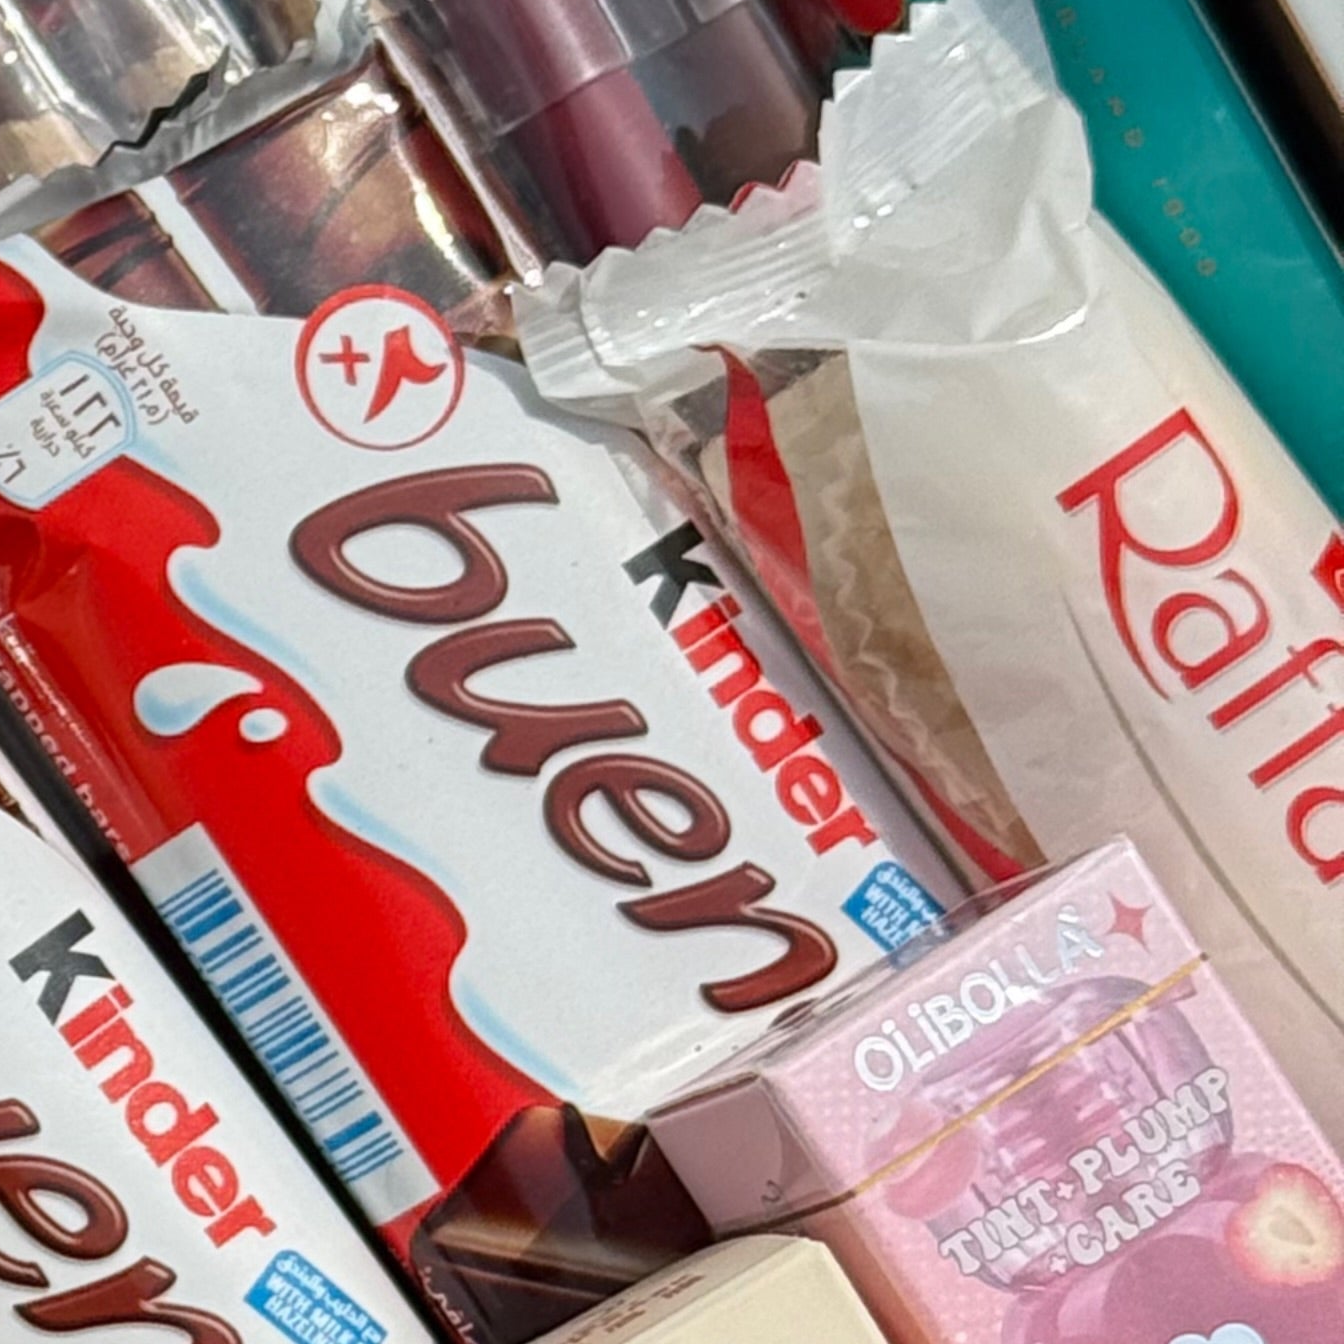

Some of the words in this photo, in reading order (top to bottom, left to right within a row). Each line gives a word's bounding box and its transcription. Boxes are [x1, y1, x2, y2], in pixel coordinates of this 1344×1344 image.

[622, 520, 880, 859] Kinder
[865, 884, 915, 925] WITH
[8, 909, 276, 1248] Kinder
[264, 1275, 311, 1315] WITH
